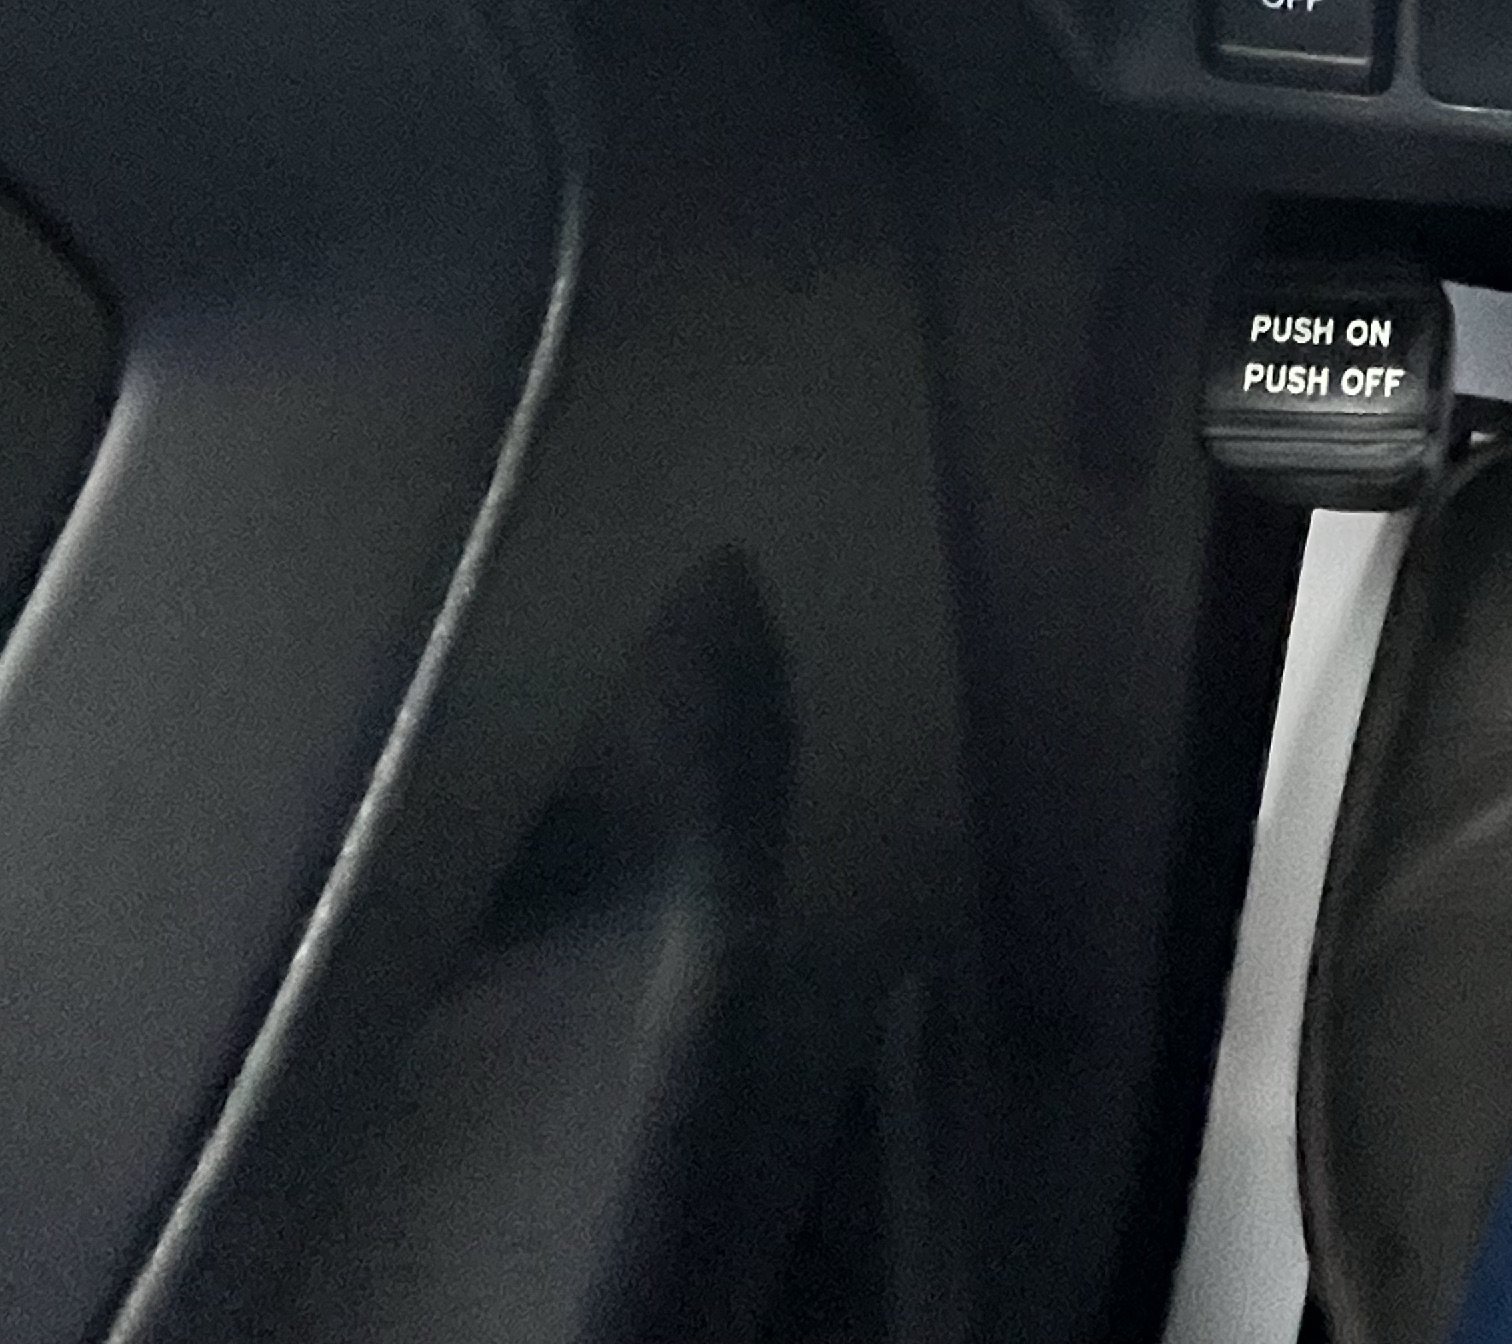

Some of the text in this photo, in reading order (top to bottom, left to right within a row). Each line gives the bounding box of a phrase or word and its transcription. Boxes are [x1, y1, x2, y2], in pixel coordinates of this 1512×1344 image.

[1251, 314, 1392, 348] PUSH ON
[1243, 363, 1406, 398] PUSH OFF
